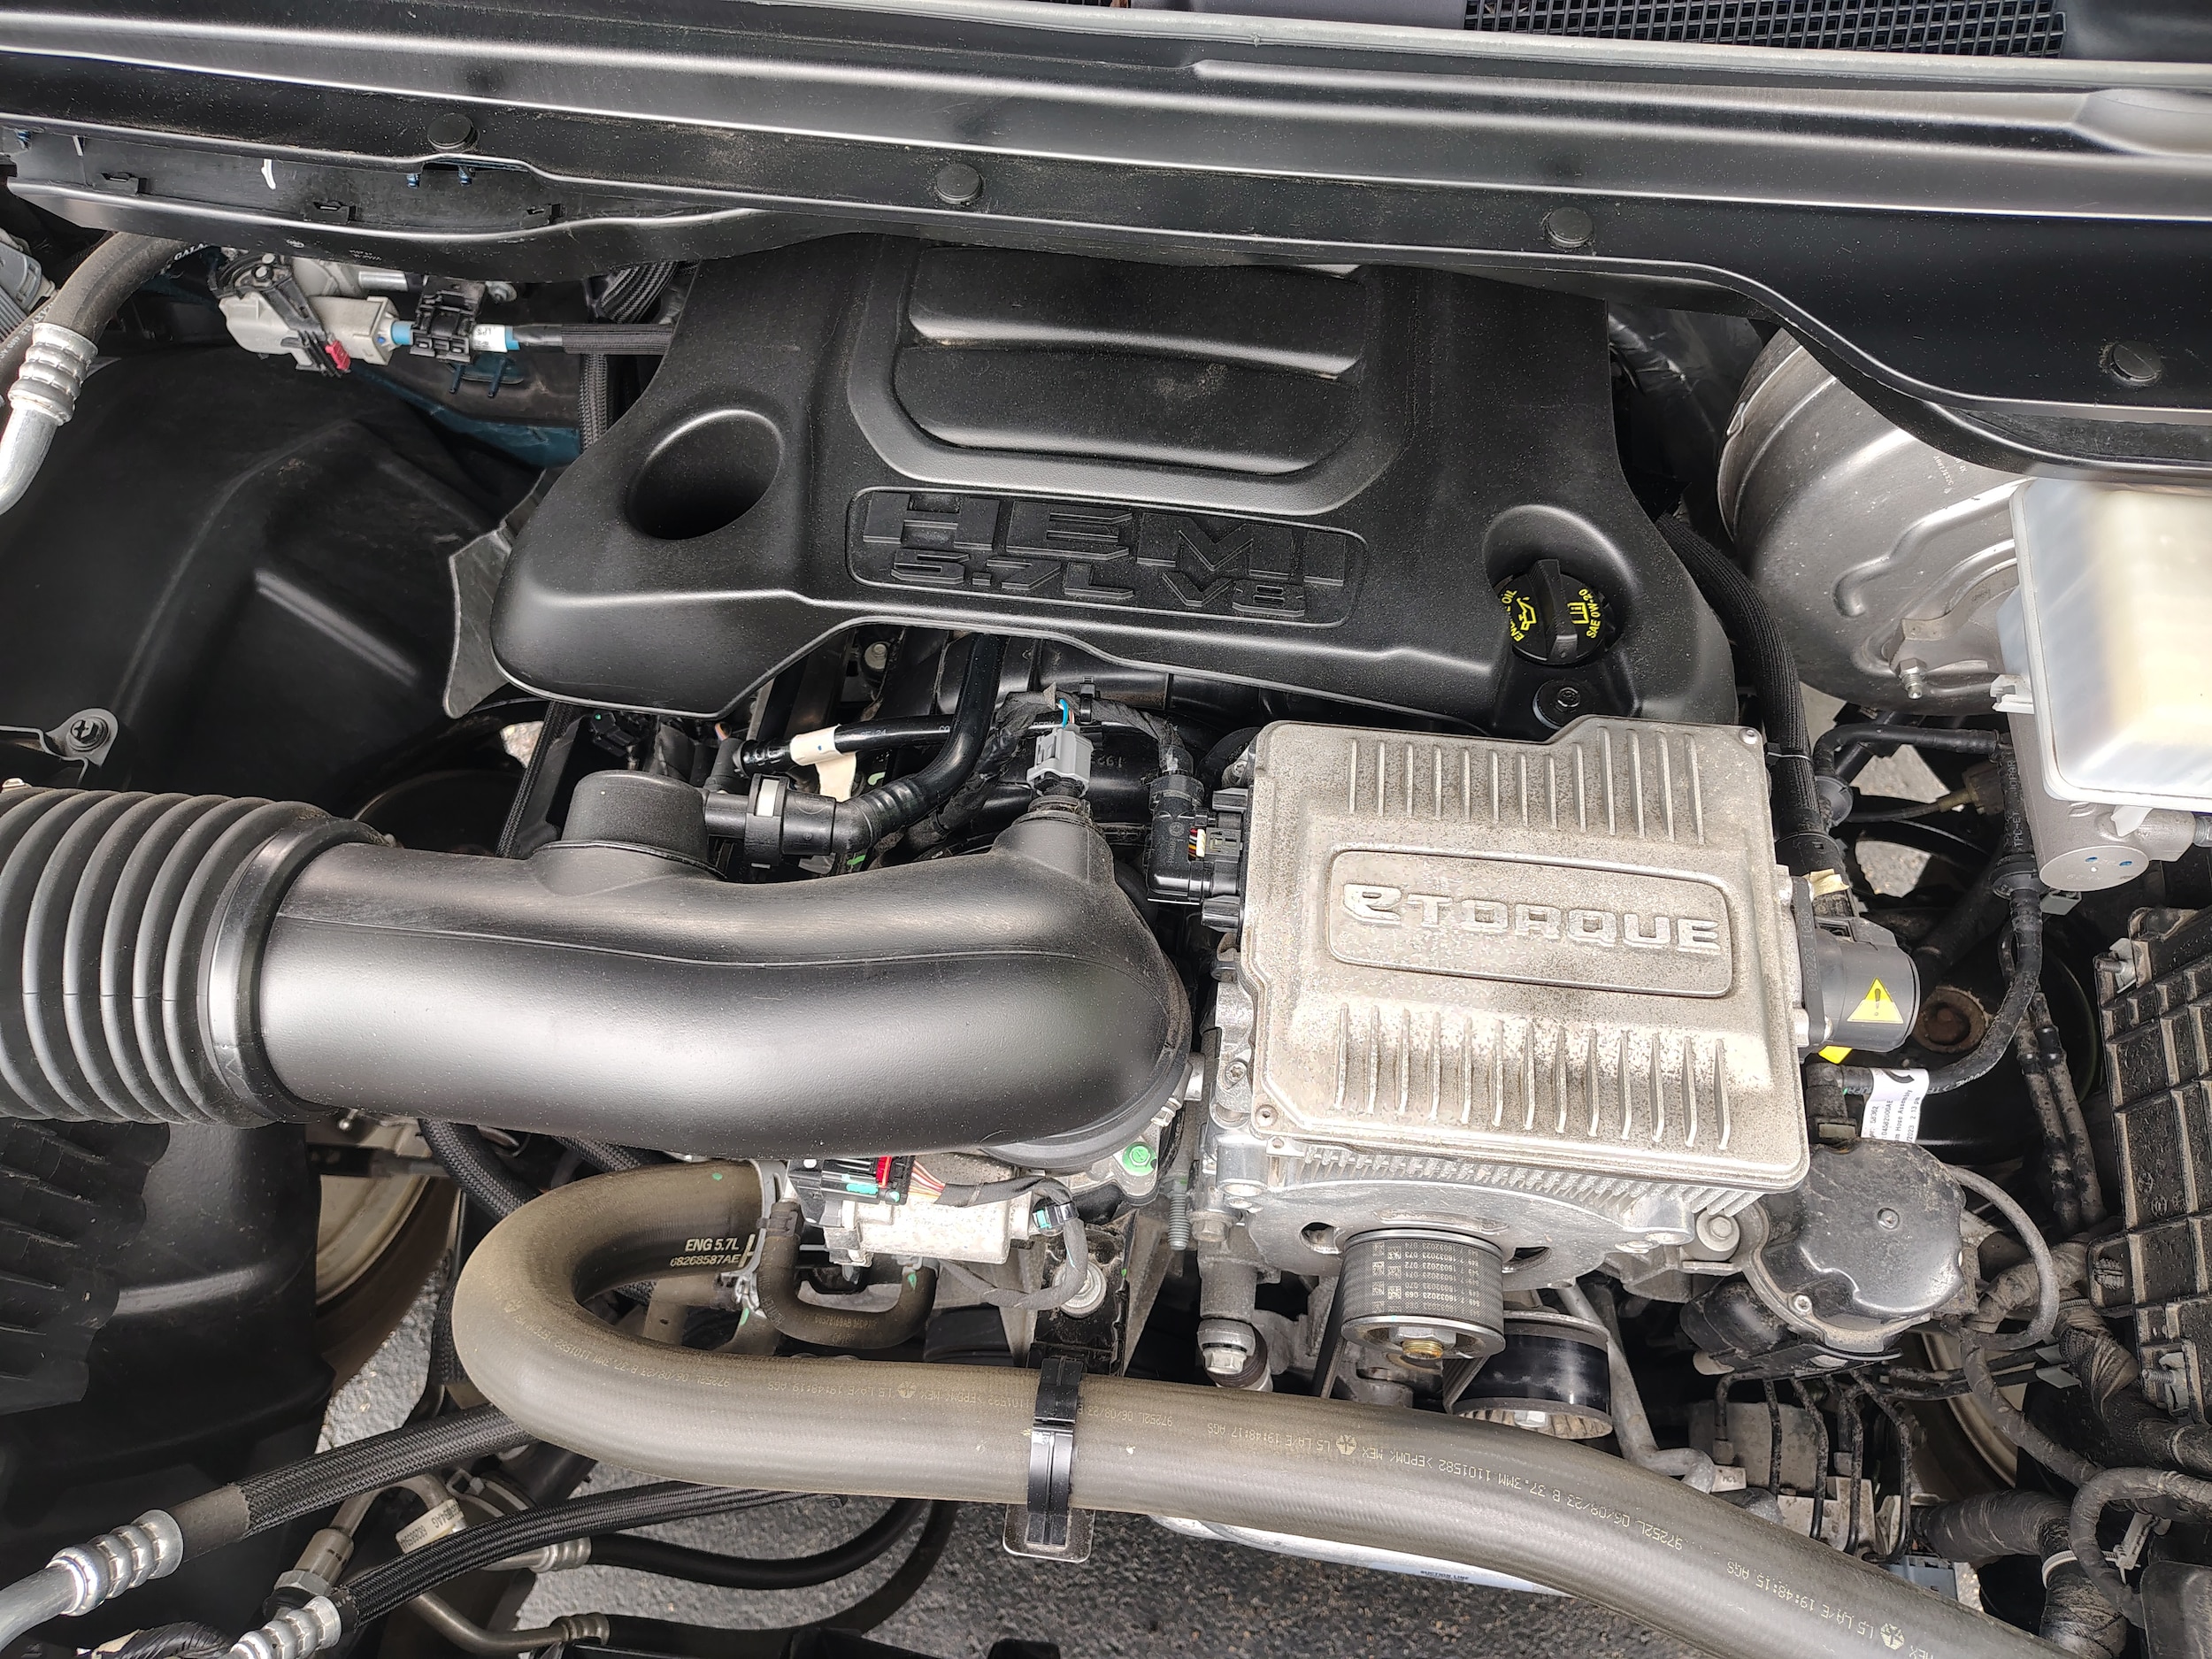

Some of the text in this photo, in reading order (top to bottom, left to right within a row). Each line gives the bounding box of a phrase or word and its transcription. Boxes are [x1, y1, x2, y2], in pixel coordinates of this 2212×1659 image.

[862, 491, 1347, 586] HEMI
[890, 548, 1307, 618] 5.7L V8
[1502, 589, 1517, 604] OIL
[1586, 620, 1601, 639] SAE
[1343, 883, 1721, 953] eTORQUE
[685, 1237, 740, 1252] ENG 5.7L
[1231, 1428, 1280, 1445] 19:48:17
[1362, 1446, 1383, 1460] MEX
[1439, 1459, 1491, 1482] 1101582
